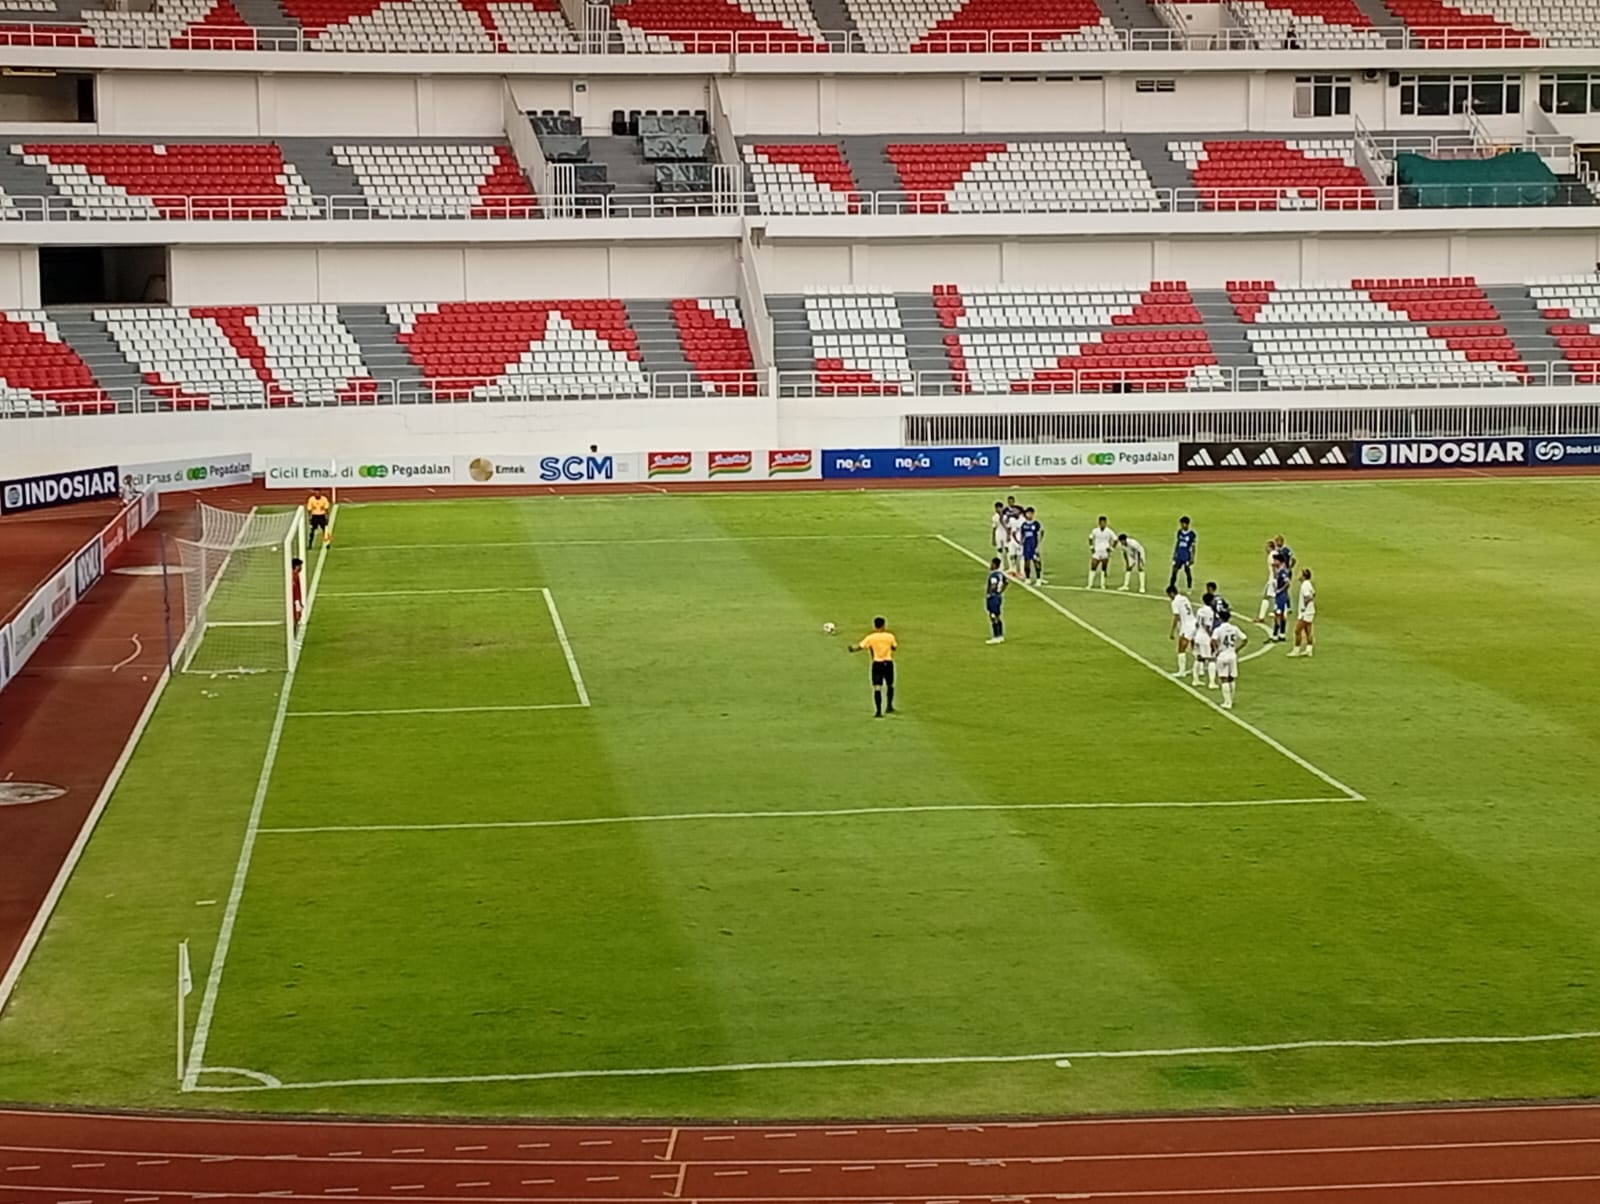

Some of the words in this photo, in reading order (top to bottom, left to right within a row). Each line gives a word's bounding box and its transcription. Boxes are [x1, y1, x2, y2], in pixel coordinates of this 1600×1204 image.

[1003, 455, 1030, 466] Cicil
[1034, 455, 1067, 466] Emas
[1071, 454, 1082, 465] di
[1119, 452, 1175, 465] Pegadaian
[1390, 442, 1525, 464] INDOSIAR
[174, 470, 183, 482] di
[270, 468, 298, 479] Cicil
[341, 467, 353, 478] di
[392, 464, 451, 477] Pegadaian
[496, 465, 526, 474] Emtek
[540, 456, 613, 481] SCM
[25, 471, 116, 505] INDOSIAR
